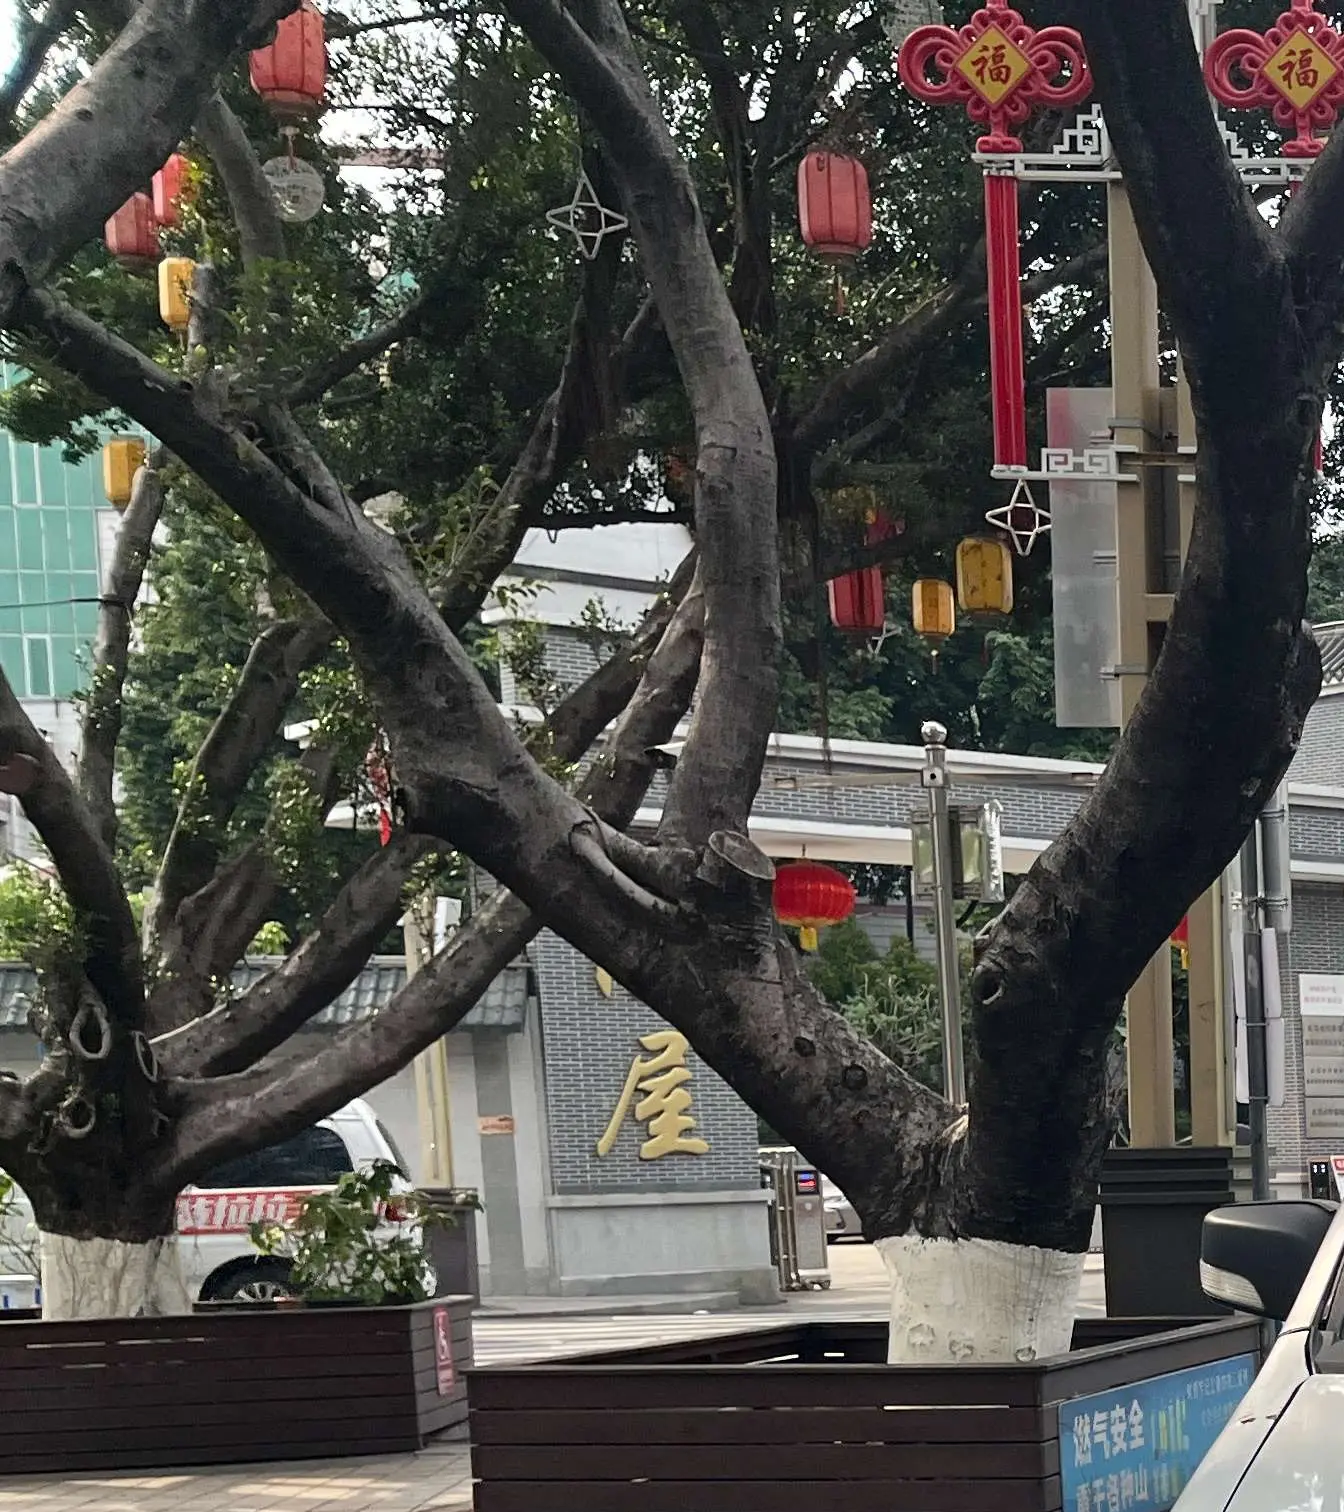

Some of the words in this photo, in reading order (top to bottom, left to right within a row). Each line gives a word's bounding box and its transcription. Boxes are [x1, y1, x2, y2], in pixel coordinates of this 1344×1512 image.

[971, 44, 1013, 85] 福
[1277, 48, 1320, 90] 福
[1073, 1399, 1145, 1468] 燃气安全
